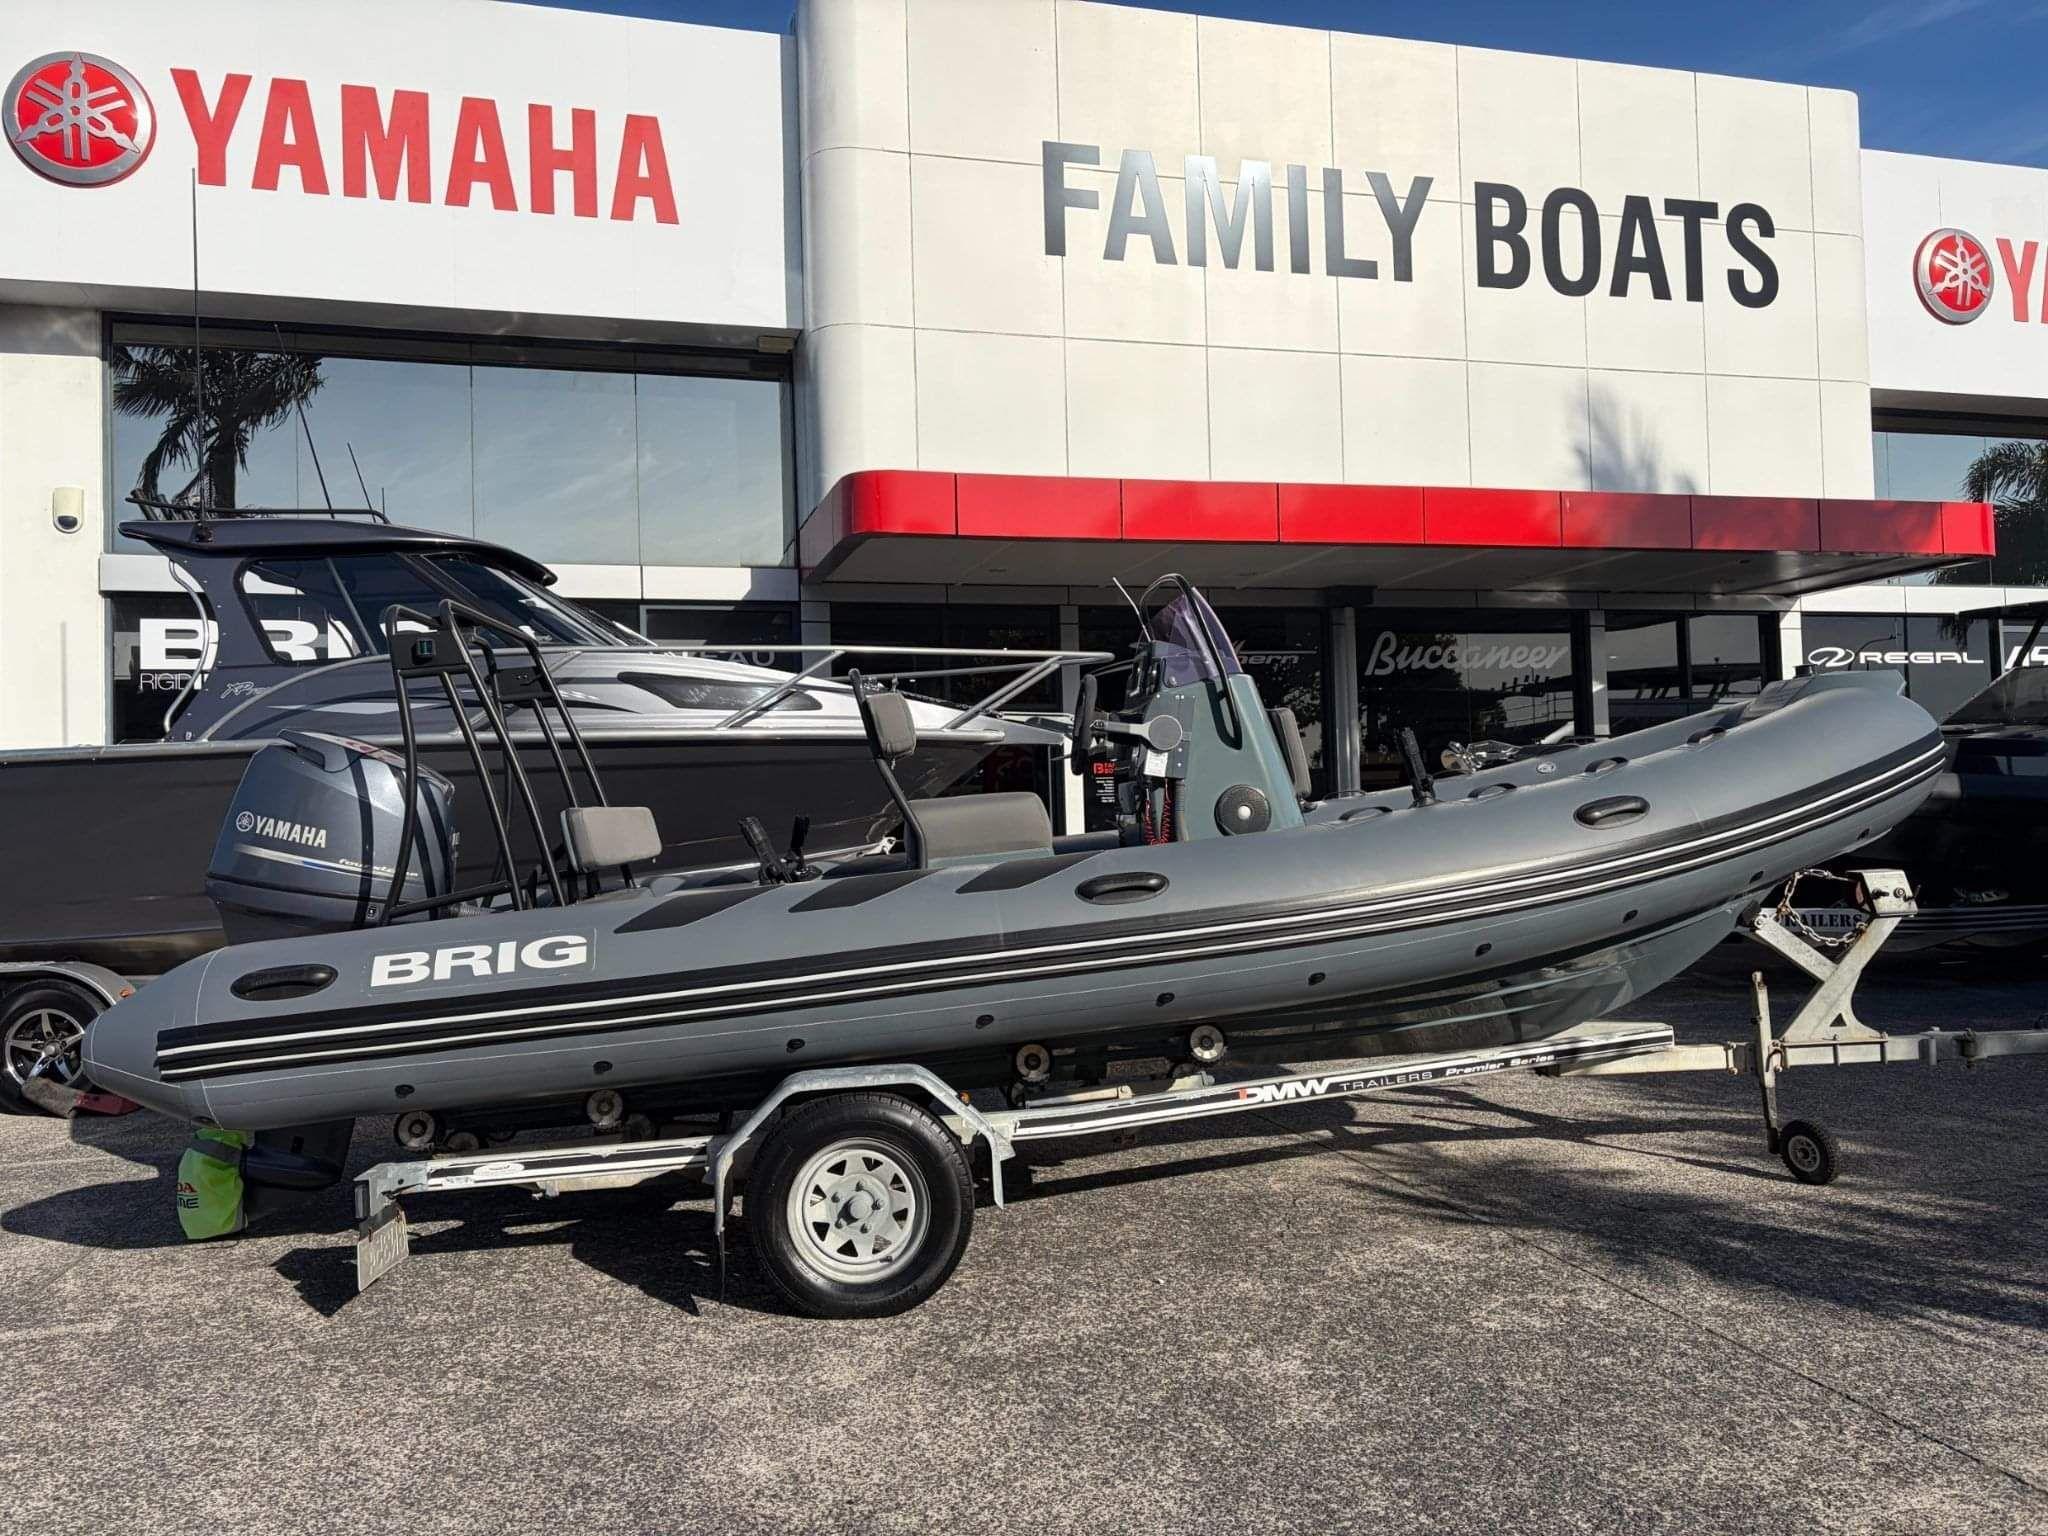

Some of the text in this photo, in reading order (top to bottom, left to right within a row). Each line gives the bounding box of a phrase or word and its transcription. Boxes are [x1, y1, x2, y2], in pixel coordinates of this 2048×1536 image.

[170, 67, 680, 225] YAMAHA
[1042, 140, 1779, 308] FAMILY BOATS
[1996, 237, 2048, 324] Y
[1364, 631, 1568, 676] Buccaneer
[1859, 652, 1985, 664] REGAL
[255, 815, 327, 848] YAMAHA
[1780, 913, 1863, 928] RAILERS
[371, 935, 587, 987] BRIG
[1239, 1055, 1555, 1102] DMW TRAILERS Premier Series
